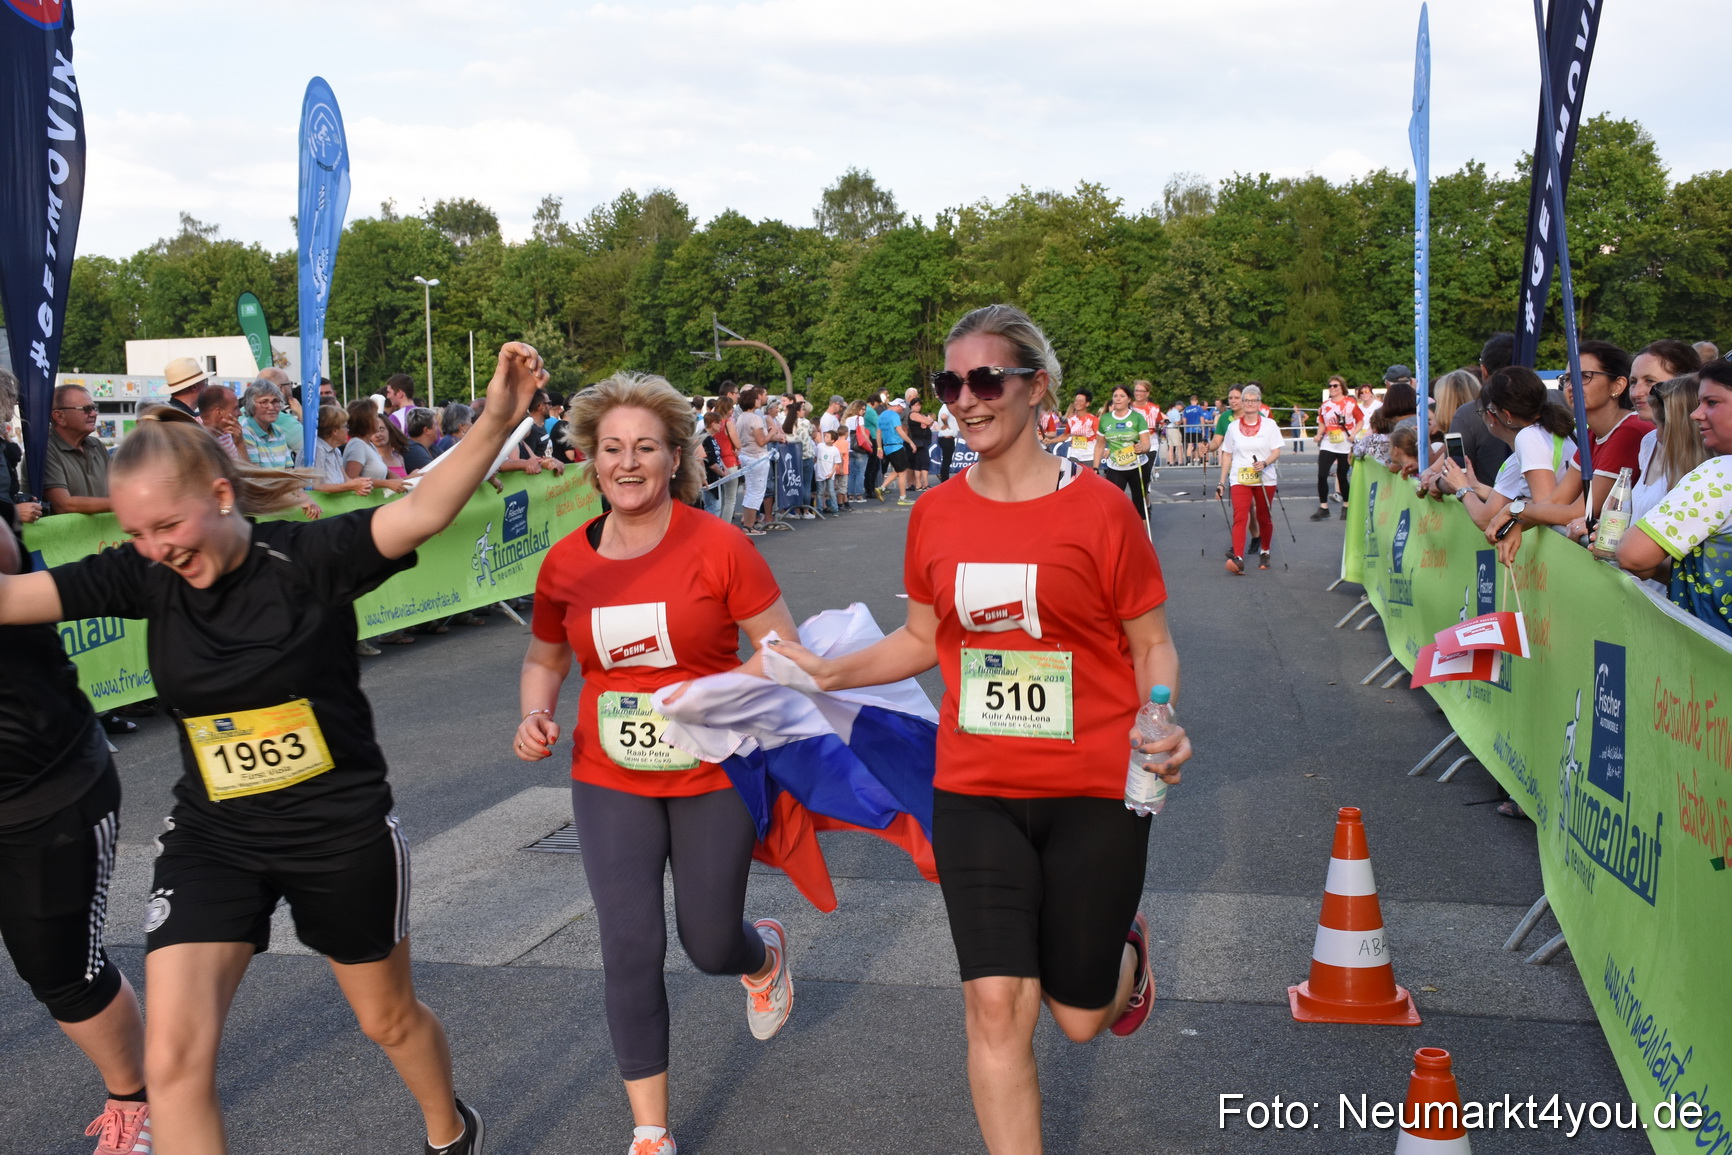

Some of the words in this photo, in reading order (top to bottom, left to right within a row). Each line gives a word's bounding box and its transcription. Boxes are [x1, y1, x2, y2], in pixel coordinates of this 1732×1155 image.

[1240, 472, 1259, 480] 1359
[493, 521, 550, 570] firmenlauf
[1480, 578, 1494, 594] Fischer
[984, 608, 1008, 621] DEHN
[624, 643, 646, 657] DEHN
[91, 668, 151, 698] www.firme
[985, 681, 1046, 712] 510
[1599, 686, 1621, 718] Fischer
[1653, 675, 1702, 752] Gesunde
[981, 712, 1003, 720] Kuhr
[1005, 713, 1051, 723] Anna-Lena
[1600, 717, 1619, 733] AUTOMOBILE
[214, 732, 306, 774] 1963
[627, 749, 647, 757] Raab
[648, 749, 670, 757] Petra
[1570, 760, 1662, 903] firmenlauf
[1571, 849, 1595, 895] neumarkt
